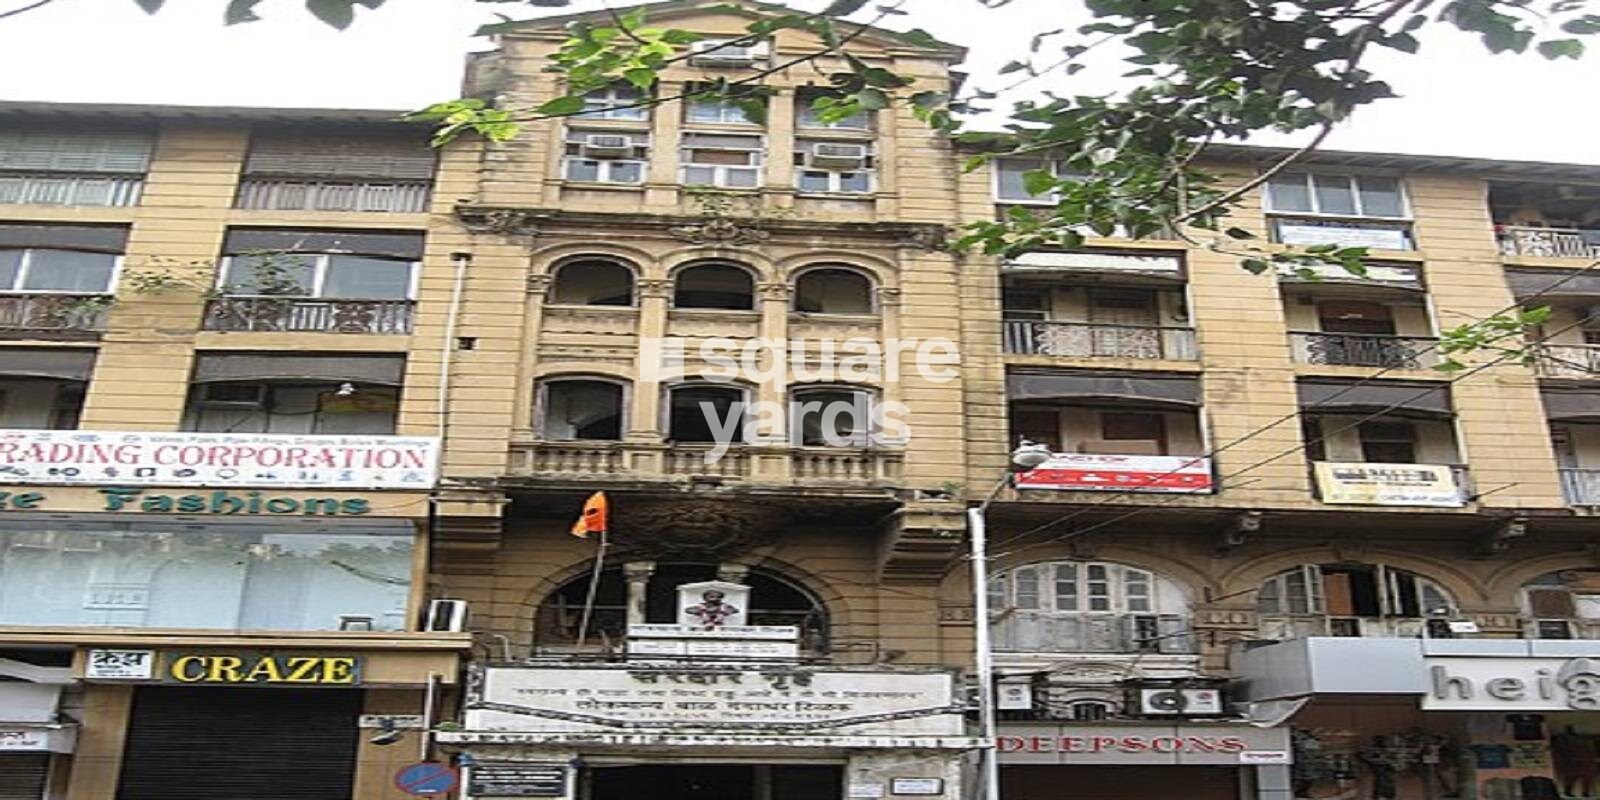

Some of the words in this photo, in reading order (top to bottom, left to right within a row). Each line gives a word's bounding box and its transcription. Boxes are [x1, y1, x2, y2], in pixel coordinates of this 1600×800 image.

[153, 445, 427, 469] CORPORATION
[97, 486, 370, 514] Fashions
[170, 655, 355, 684] CRAZE
[996, 735, 1248, 753] DEEPSONS
